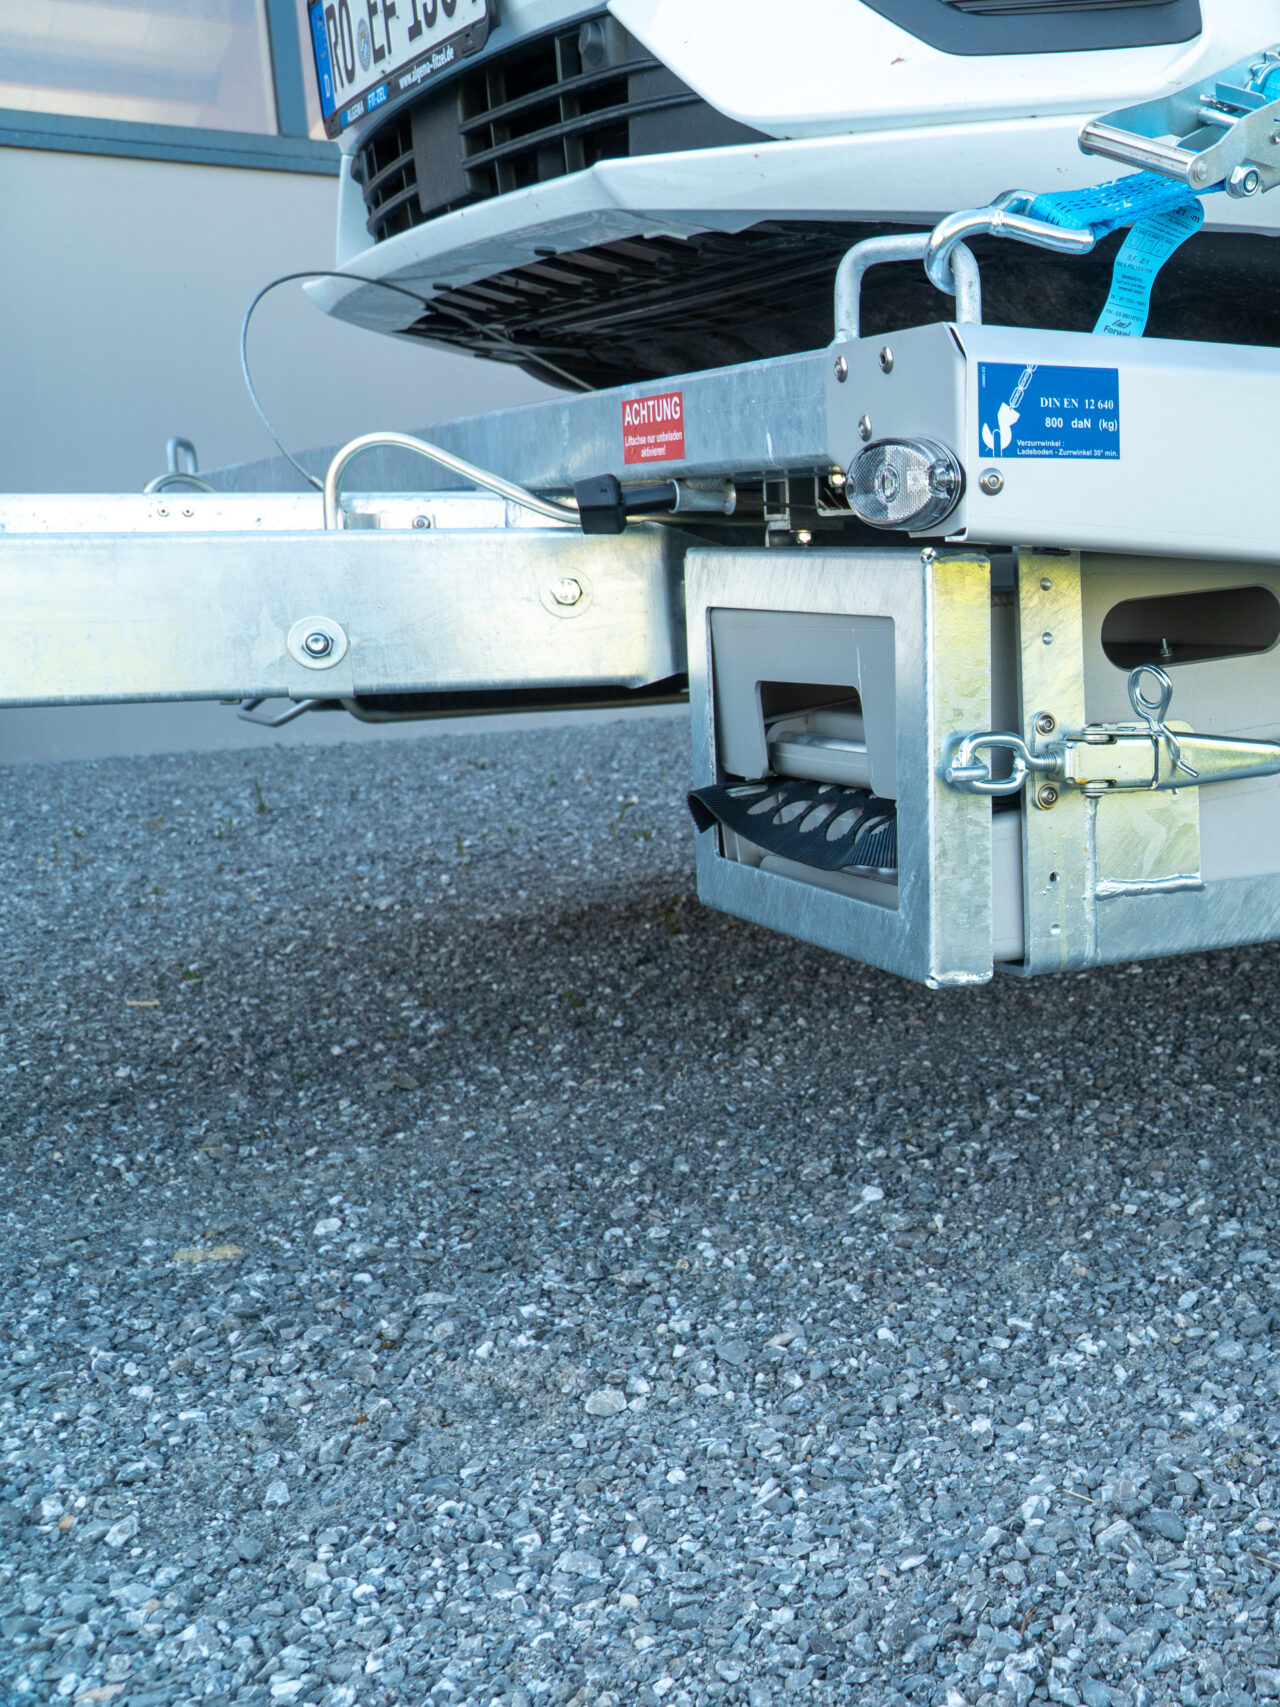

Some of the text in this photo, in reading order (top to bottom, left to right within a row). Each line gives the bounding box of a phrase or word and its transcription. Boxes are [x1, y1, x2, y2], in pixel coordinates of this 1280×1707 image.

[399, 45, 454, 90] www.algema-fitzel.de
[347, 101, 365, 122] ALGEMA
[1040, 397, 1114, 409] DIN EN 12 640
[624, 396, 681, 426] ACHTUNG
[1045, 417, 1118, 432] 800 daN (kg)
[1017, 439, 1061, 447] Verzurrwinkel
[1058, 448, 1092, 456] Zurrwinkel
